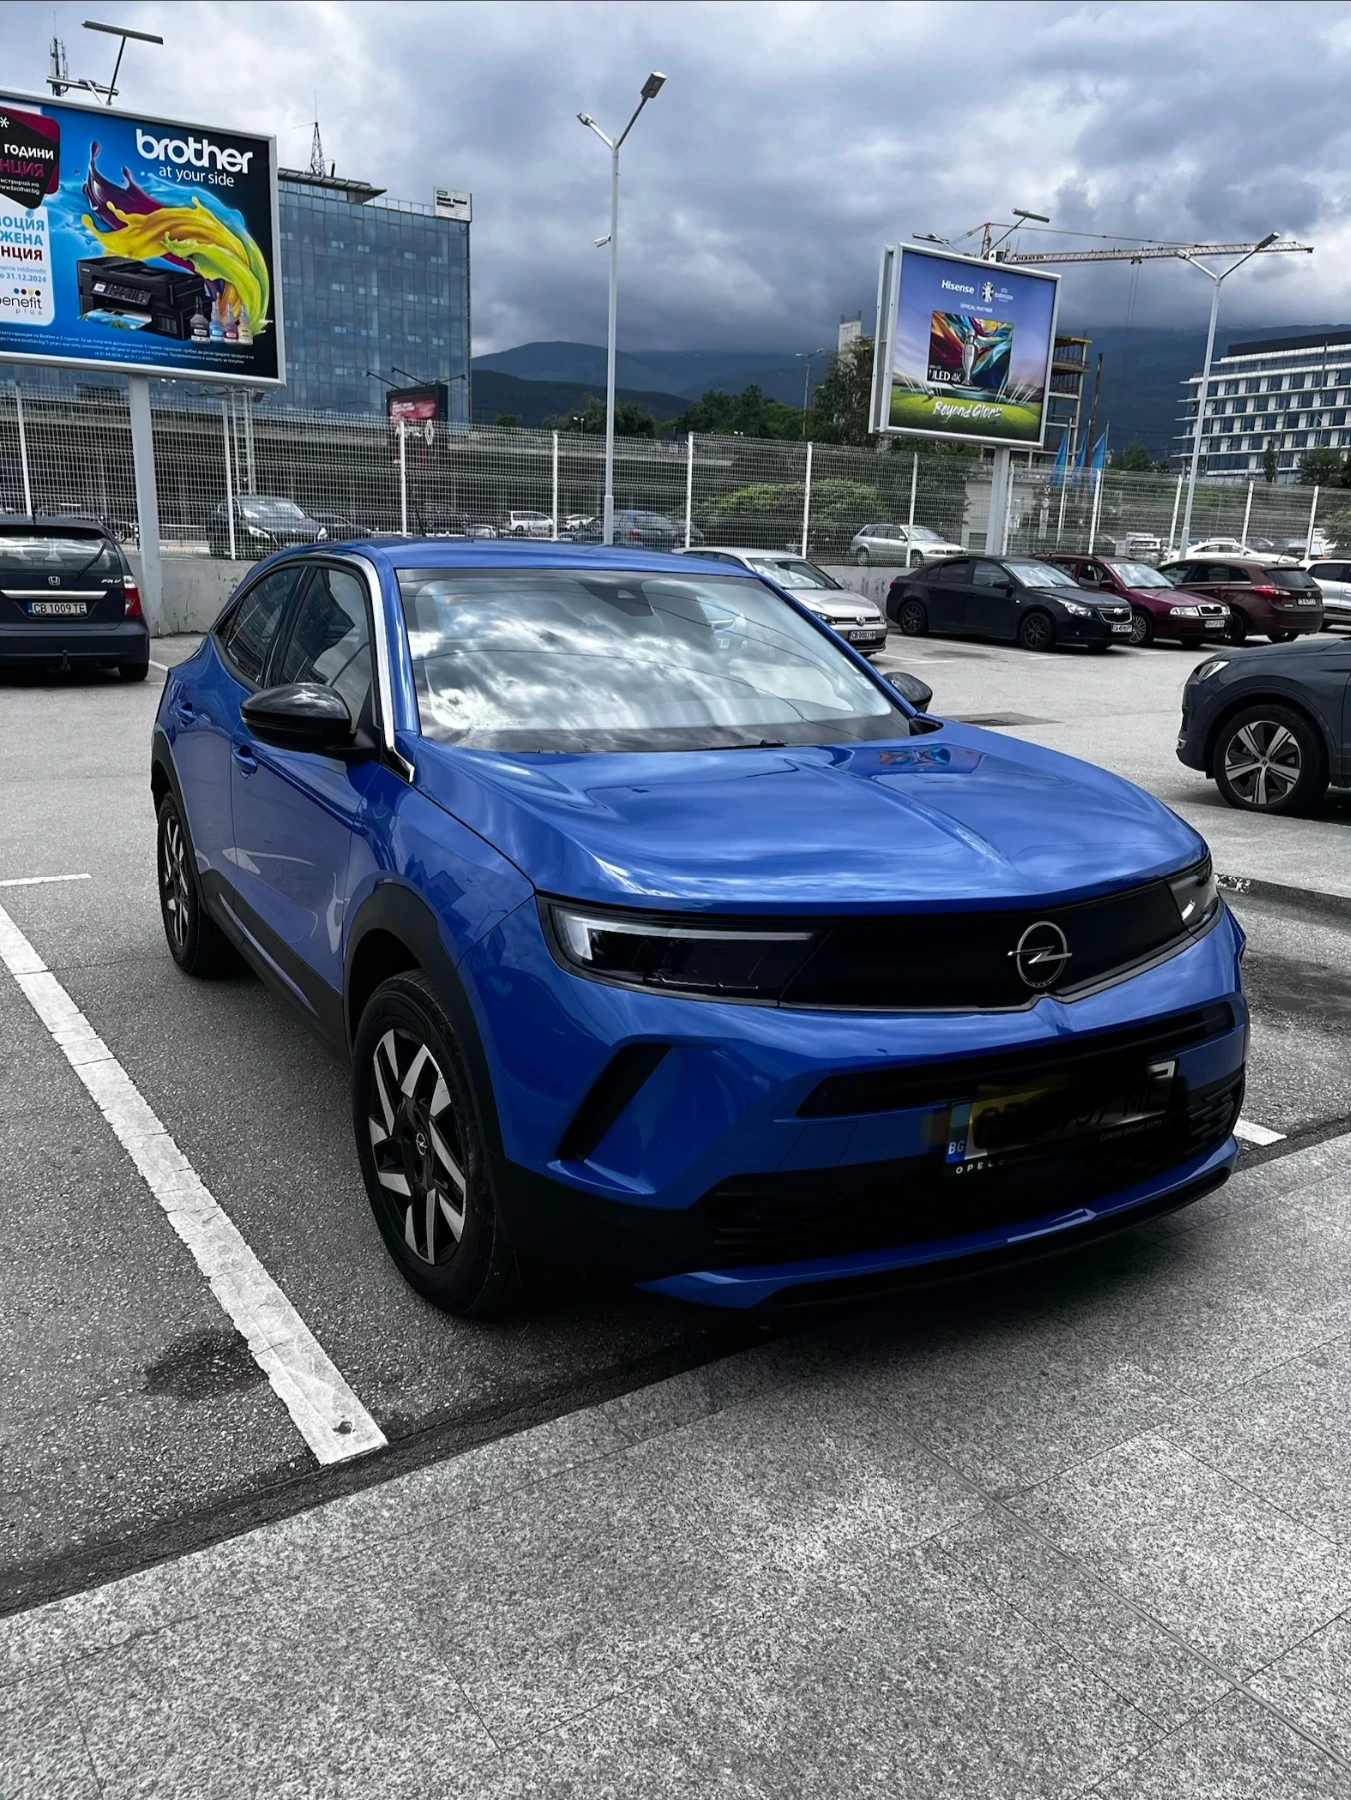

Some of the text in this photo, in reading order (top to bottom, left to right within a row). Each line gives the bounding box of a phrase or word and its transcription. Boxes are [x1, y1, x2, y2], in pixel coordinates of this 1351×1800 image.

[136, 128, 253, 174] brother
[159, 165, 234, 187] at your side
[0, 215, 45, 232] ОЦИЯ
[6, 273, 47, 283] 31.12.2024
[941, 279, 975, 294] Hisense
[0, 296, 42, 309] enefit
[16, 308, 42, 316] plus
[932, 401, 973, 424] Beyond
[33, 603, 85, 613] CB 1009 TE
[948, 1140, 965, 1155] BG
[955, 1160, 994, 1174] OPEL
